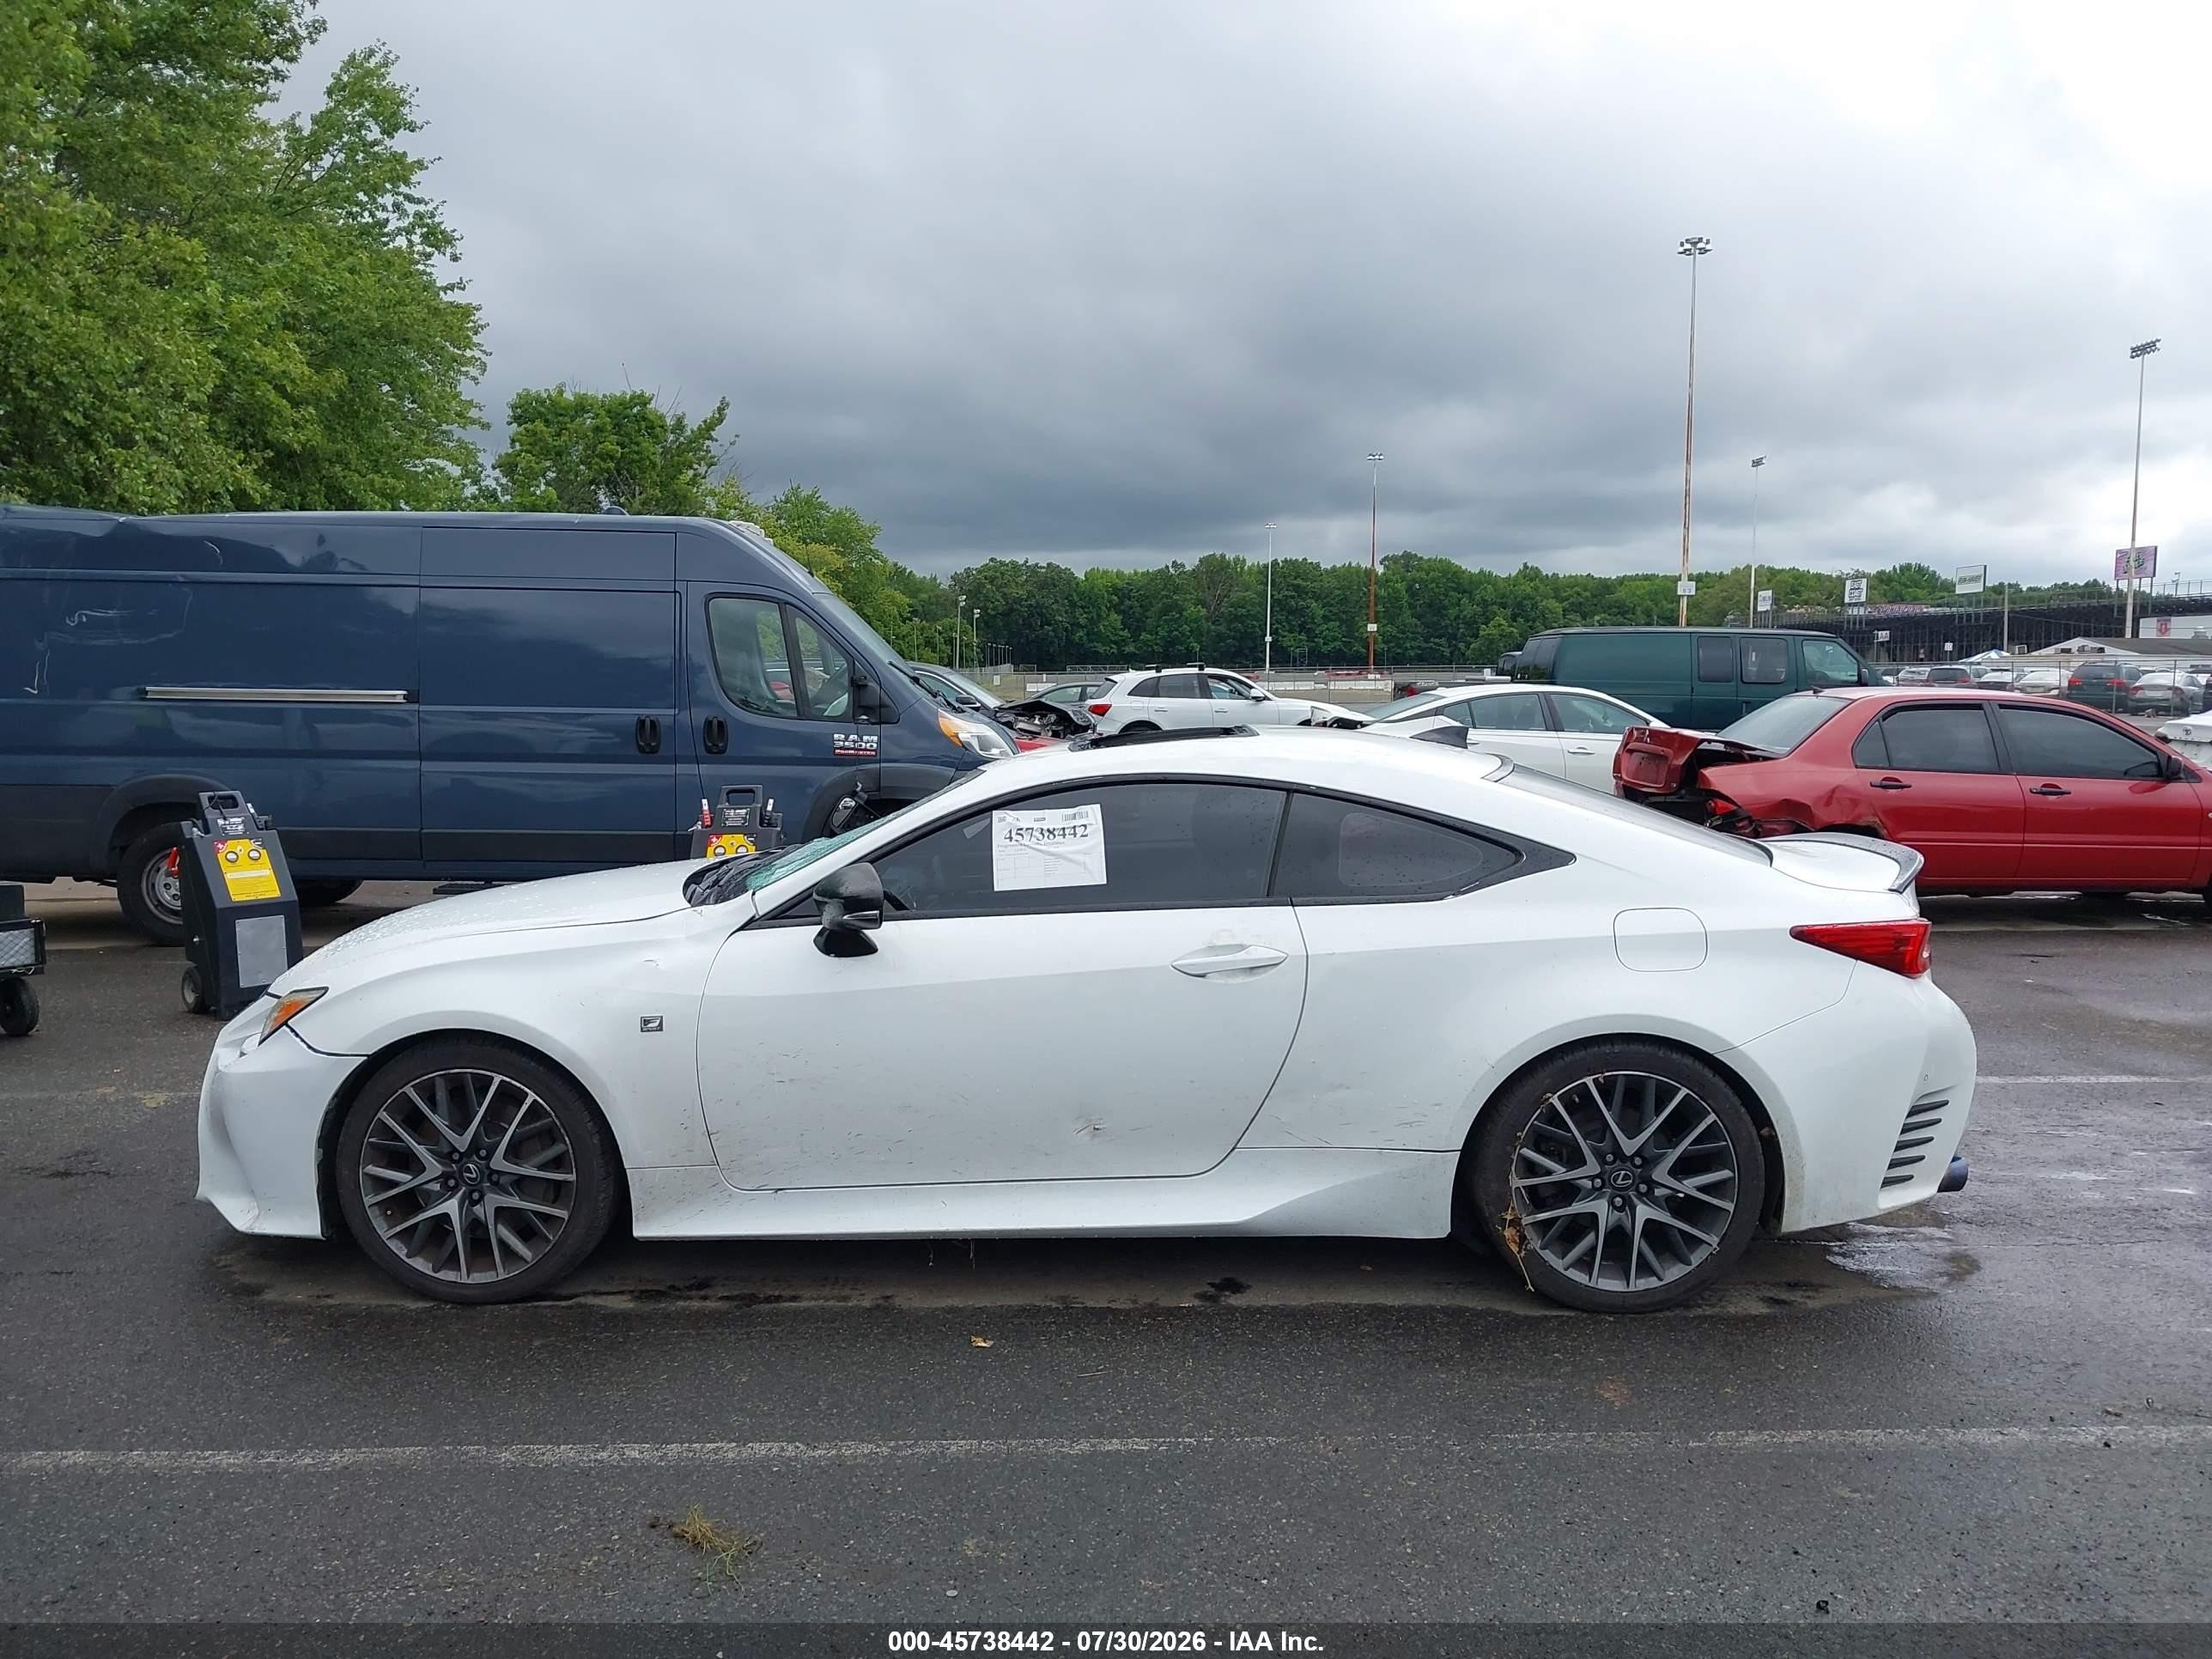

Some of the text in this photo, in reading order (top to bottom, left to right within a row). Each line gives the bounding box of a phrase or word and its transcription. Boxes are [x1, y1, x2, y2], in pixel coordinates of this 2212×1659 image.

[833, 733, 878, 743] RAM
[833, 741, 878, 750] 3500
[1004, 823, 1089, 842] 45738442
